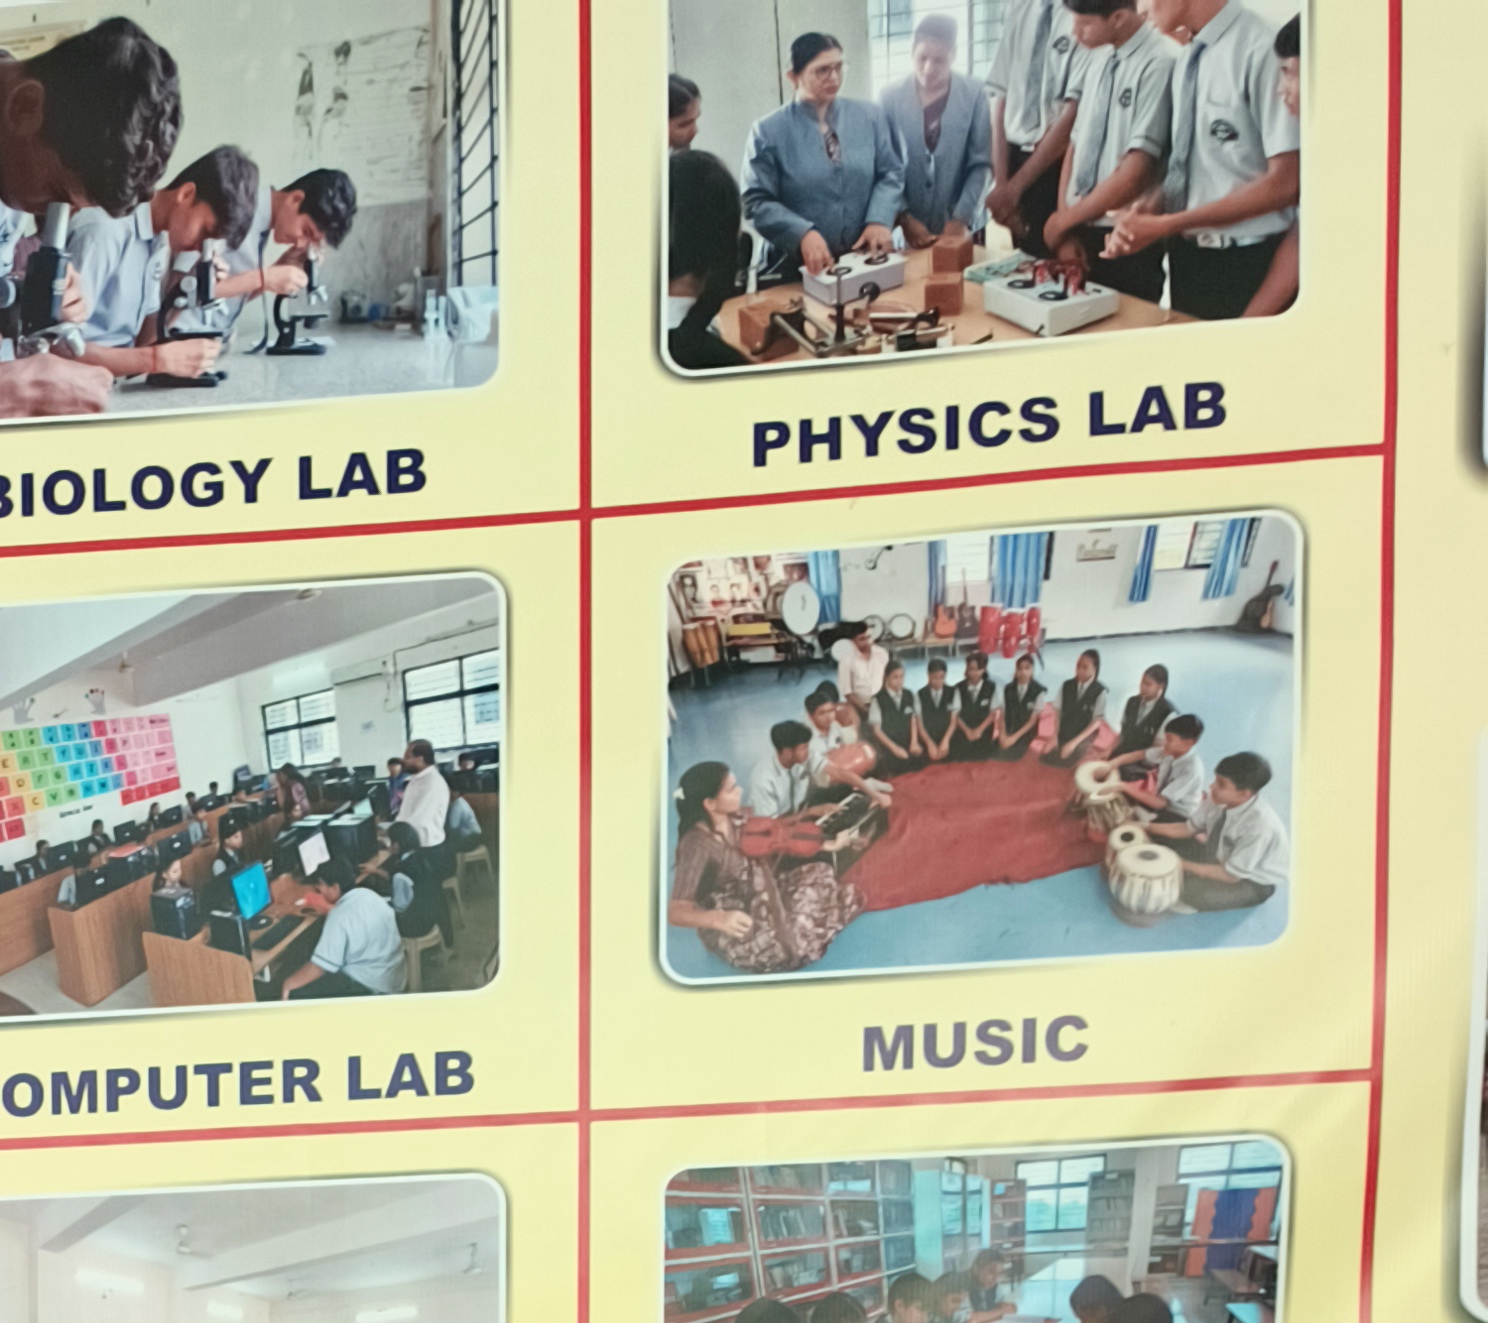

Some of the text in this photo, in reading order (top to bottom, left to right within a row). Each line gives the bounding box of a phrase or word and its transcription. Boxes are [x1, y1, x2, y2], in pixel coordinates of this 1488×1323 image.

[754, 382, 1225, 466] PHYSICS LAB
[299, 449, 425, 500] LAB
[864, 1016, 1085, 1071] MUSIC
[348, 1051, 473, 1100] LAB
